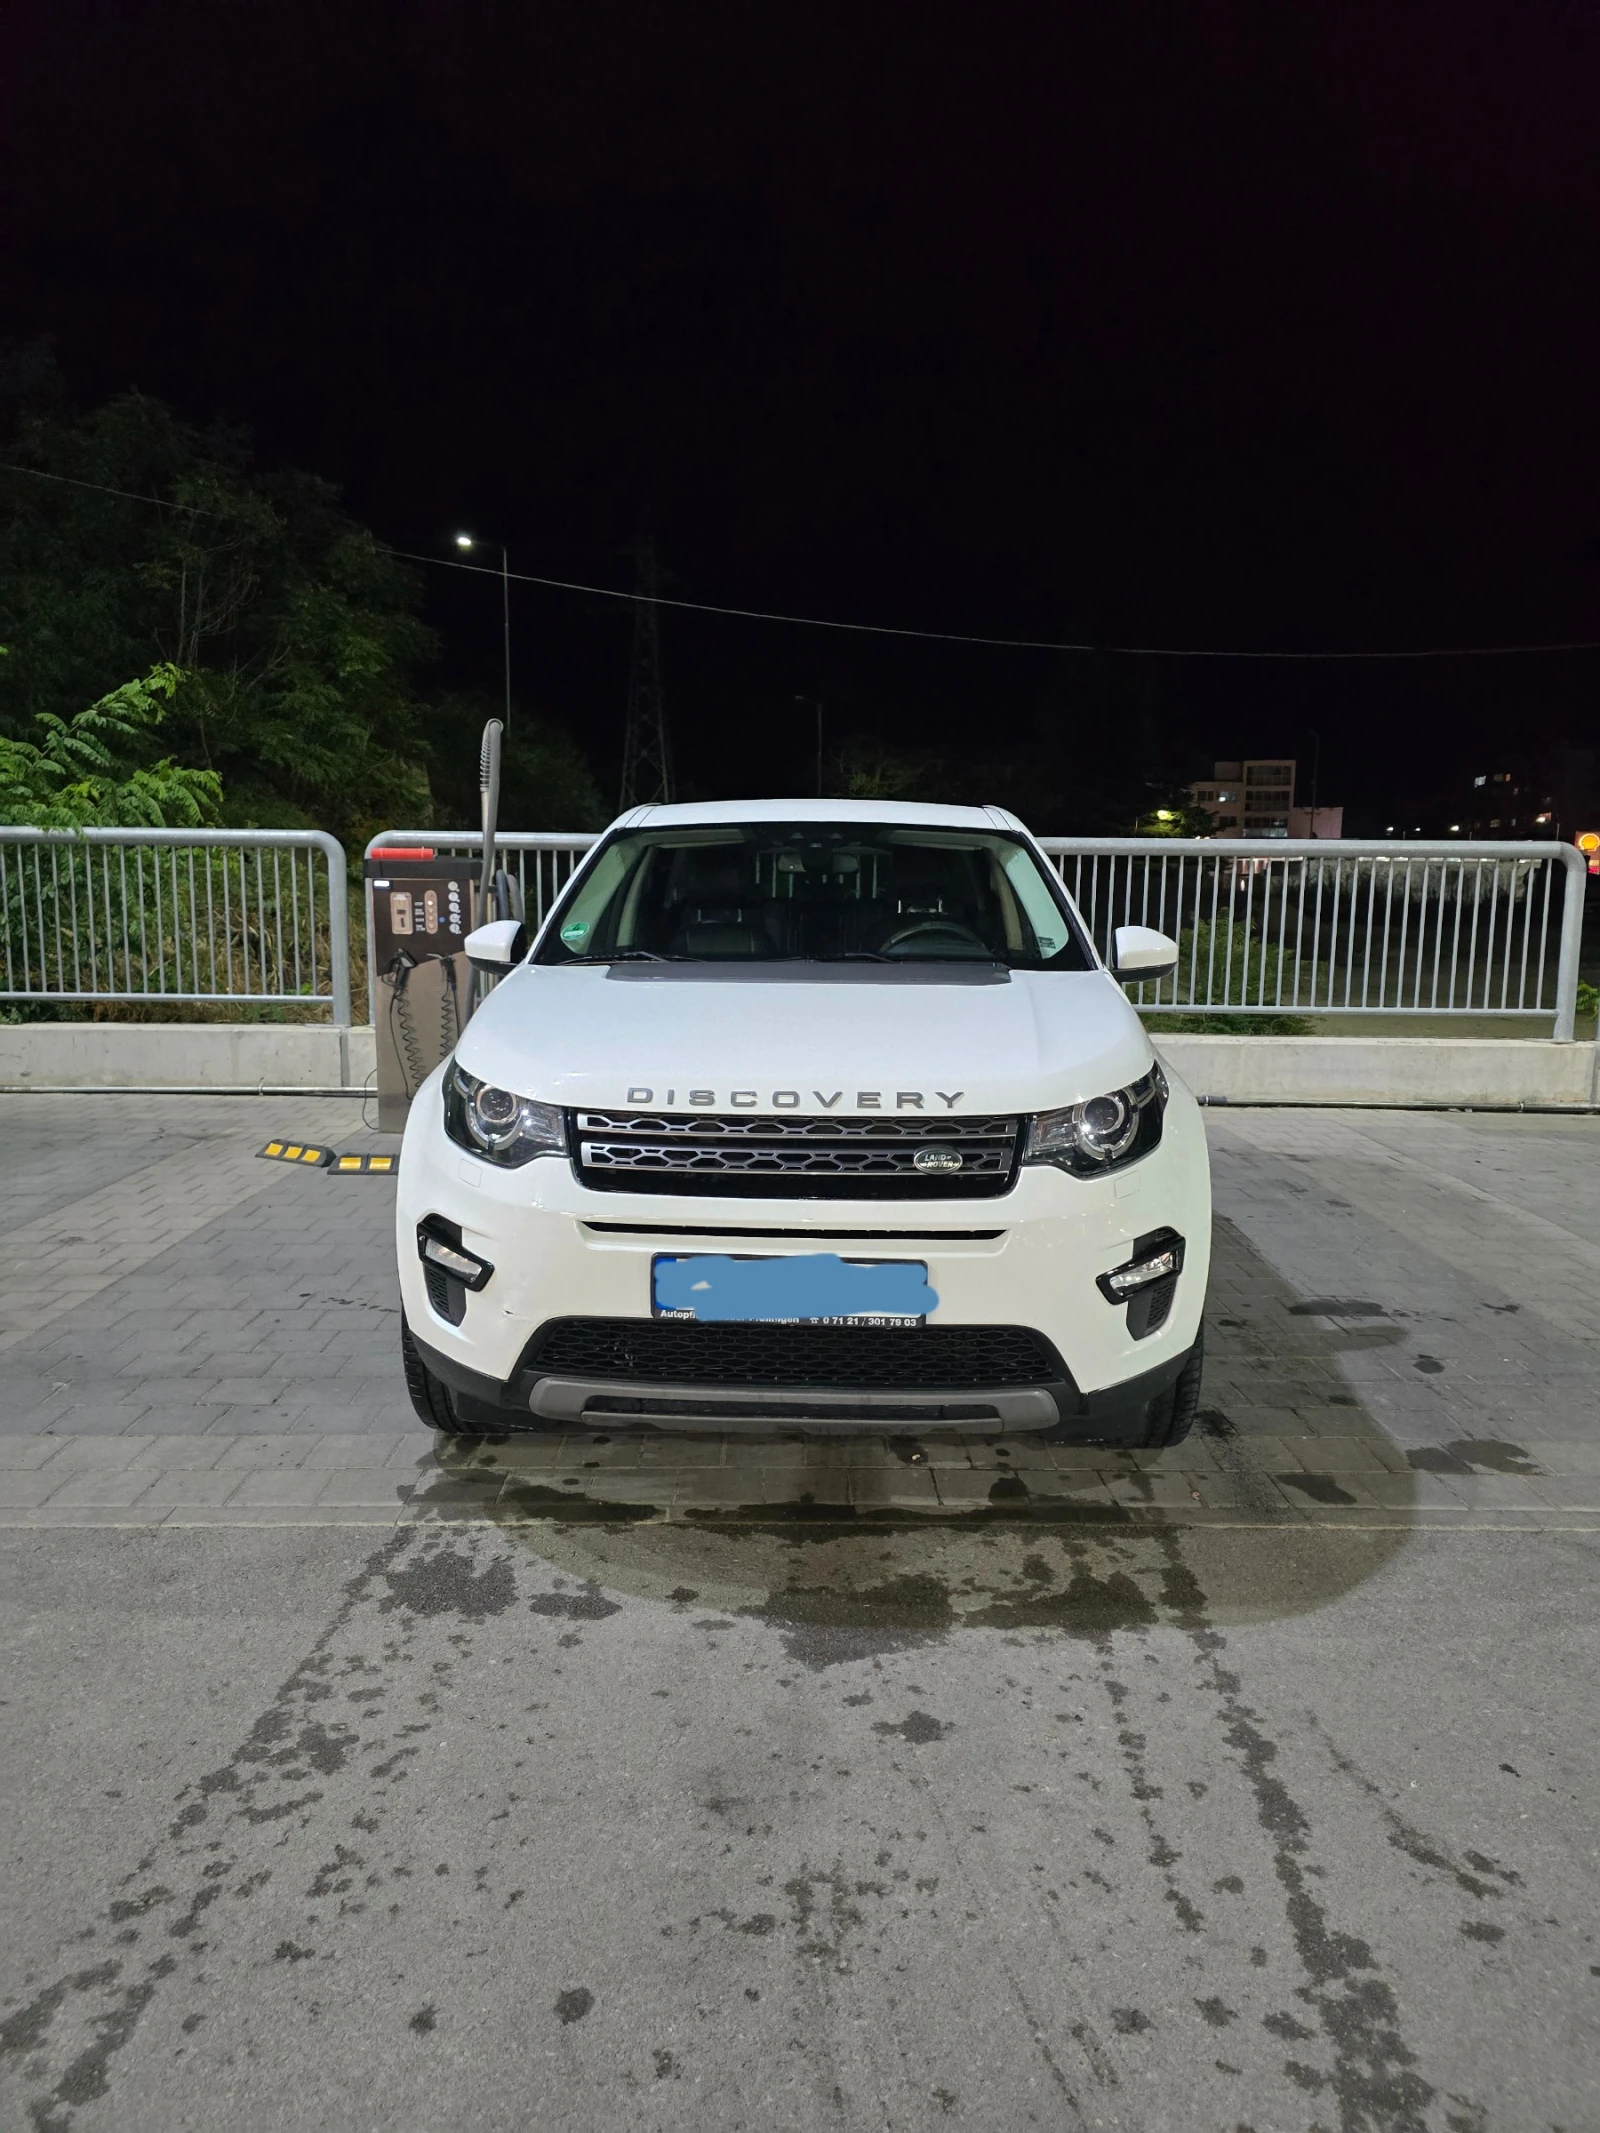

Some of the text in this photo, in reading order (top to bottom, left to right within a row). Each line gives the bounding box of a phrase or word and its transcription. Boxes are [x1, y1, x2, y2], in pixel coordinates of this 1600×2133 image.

[627, 1087, 965, 1109] DISCOVERY
[822, 1316, 830, 1325] 0
[832, 1316, 844, 1325] 71
[846, 1317, 859, 1326] 21
[868, 1317, 886, 1326] 301
[889, 1318, 902, 1327] 79
[903, 1318, 917, 1327] 03
